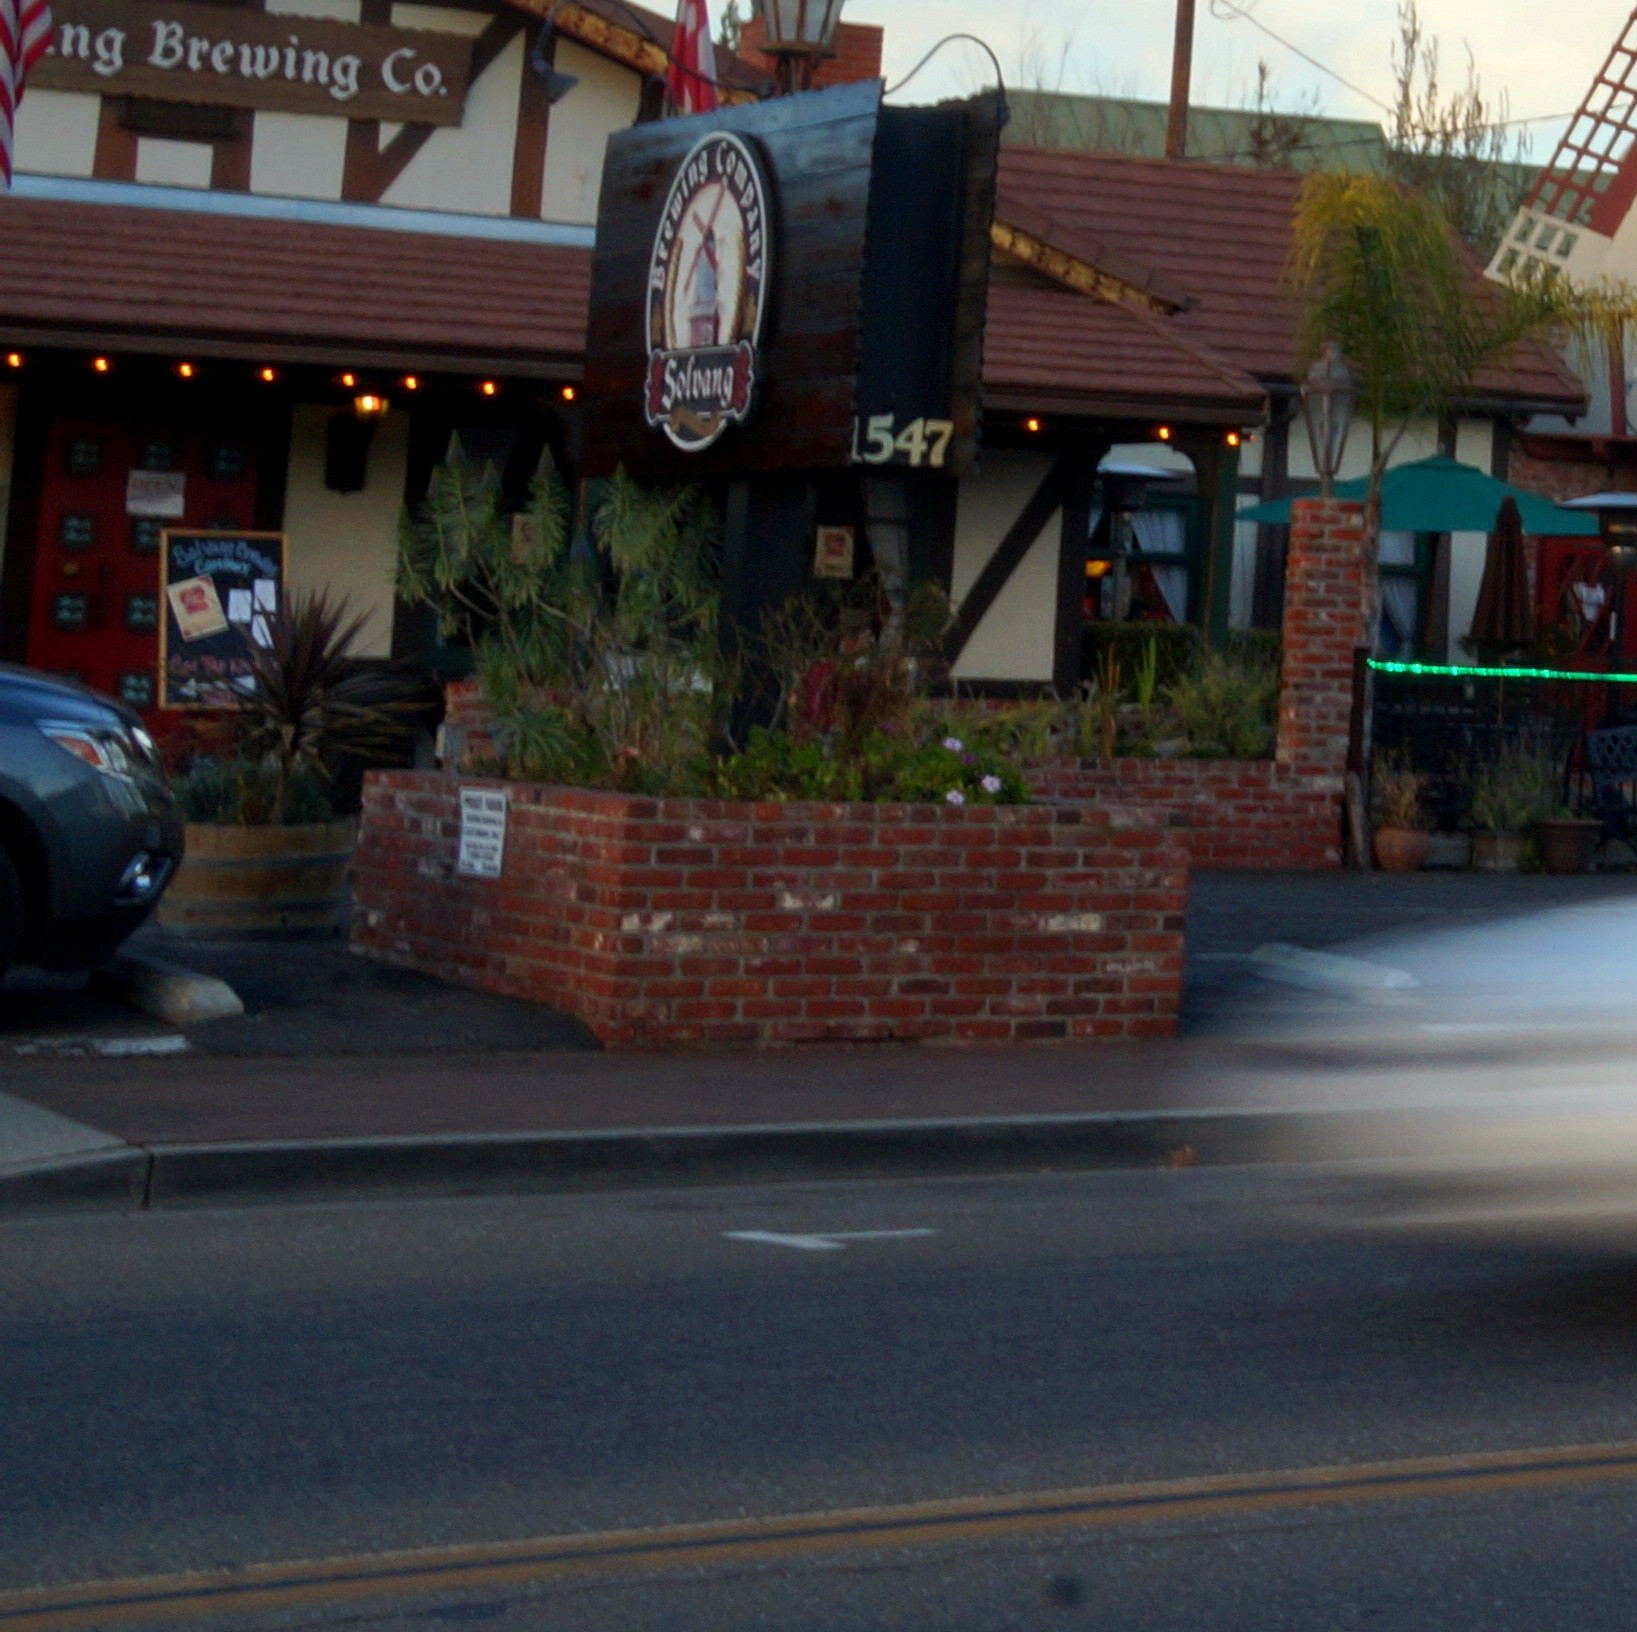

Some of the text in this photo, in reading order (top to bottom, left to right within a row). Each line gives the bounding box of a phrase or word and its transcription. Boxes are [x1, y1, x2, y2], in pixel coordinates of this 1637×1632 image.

[147, 19, 362, 101] Brewing
[381, 47, 448, 97] Co.
[649, 140, 762, 291] Brewing Company
[661, 354, 735, 411] Solvang
